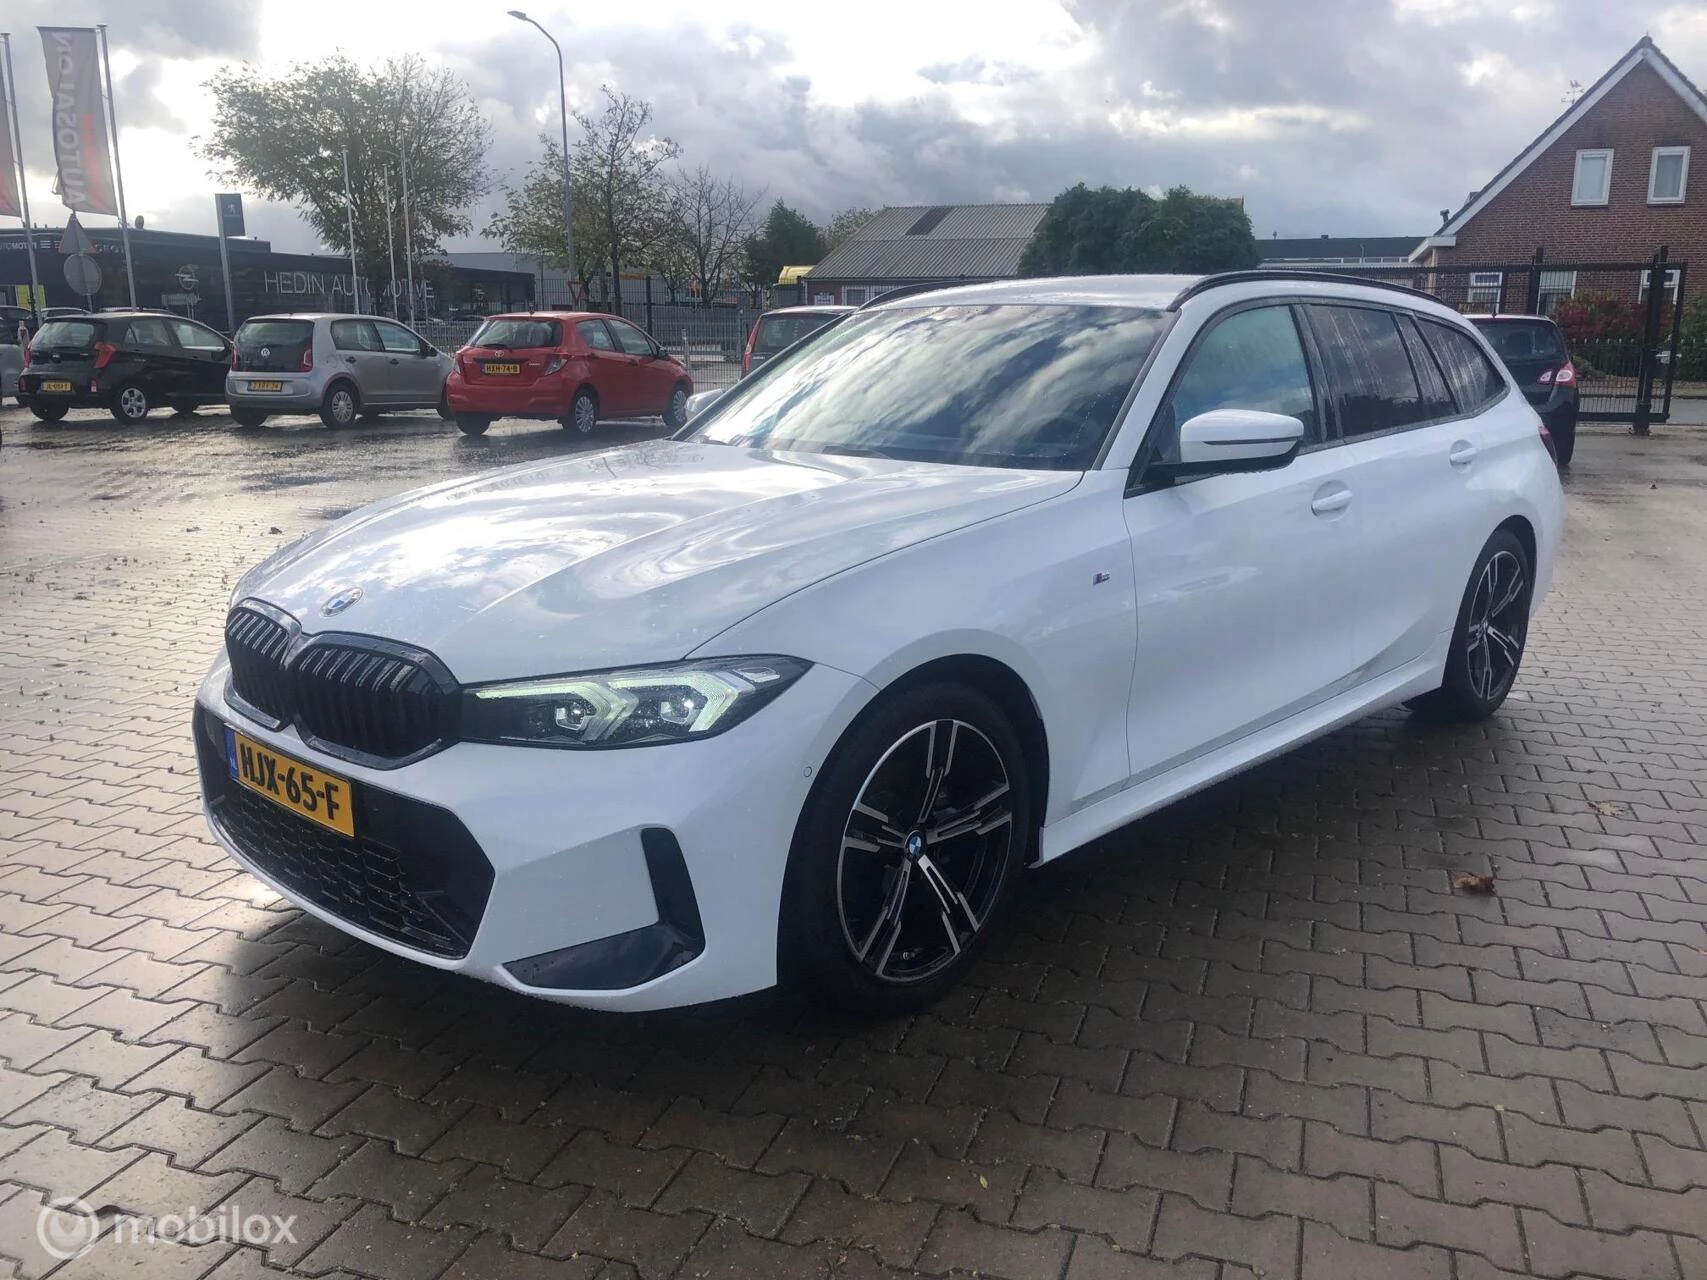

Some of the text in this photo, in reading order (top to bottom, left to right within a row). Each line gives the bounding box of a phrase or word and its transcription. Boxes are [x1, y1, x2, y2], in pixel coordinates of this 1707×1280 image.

[264, 271, 435, 298] HEDIN AUTOTVE
[239, 741, 340, 821] HJX-65-F
